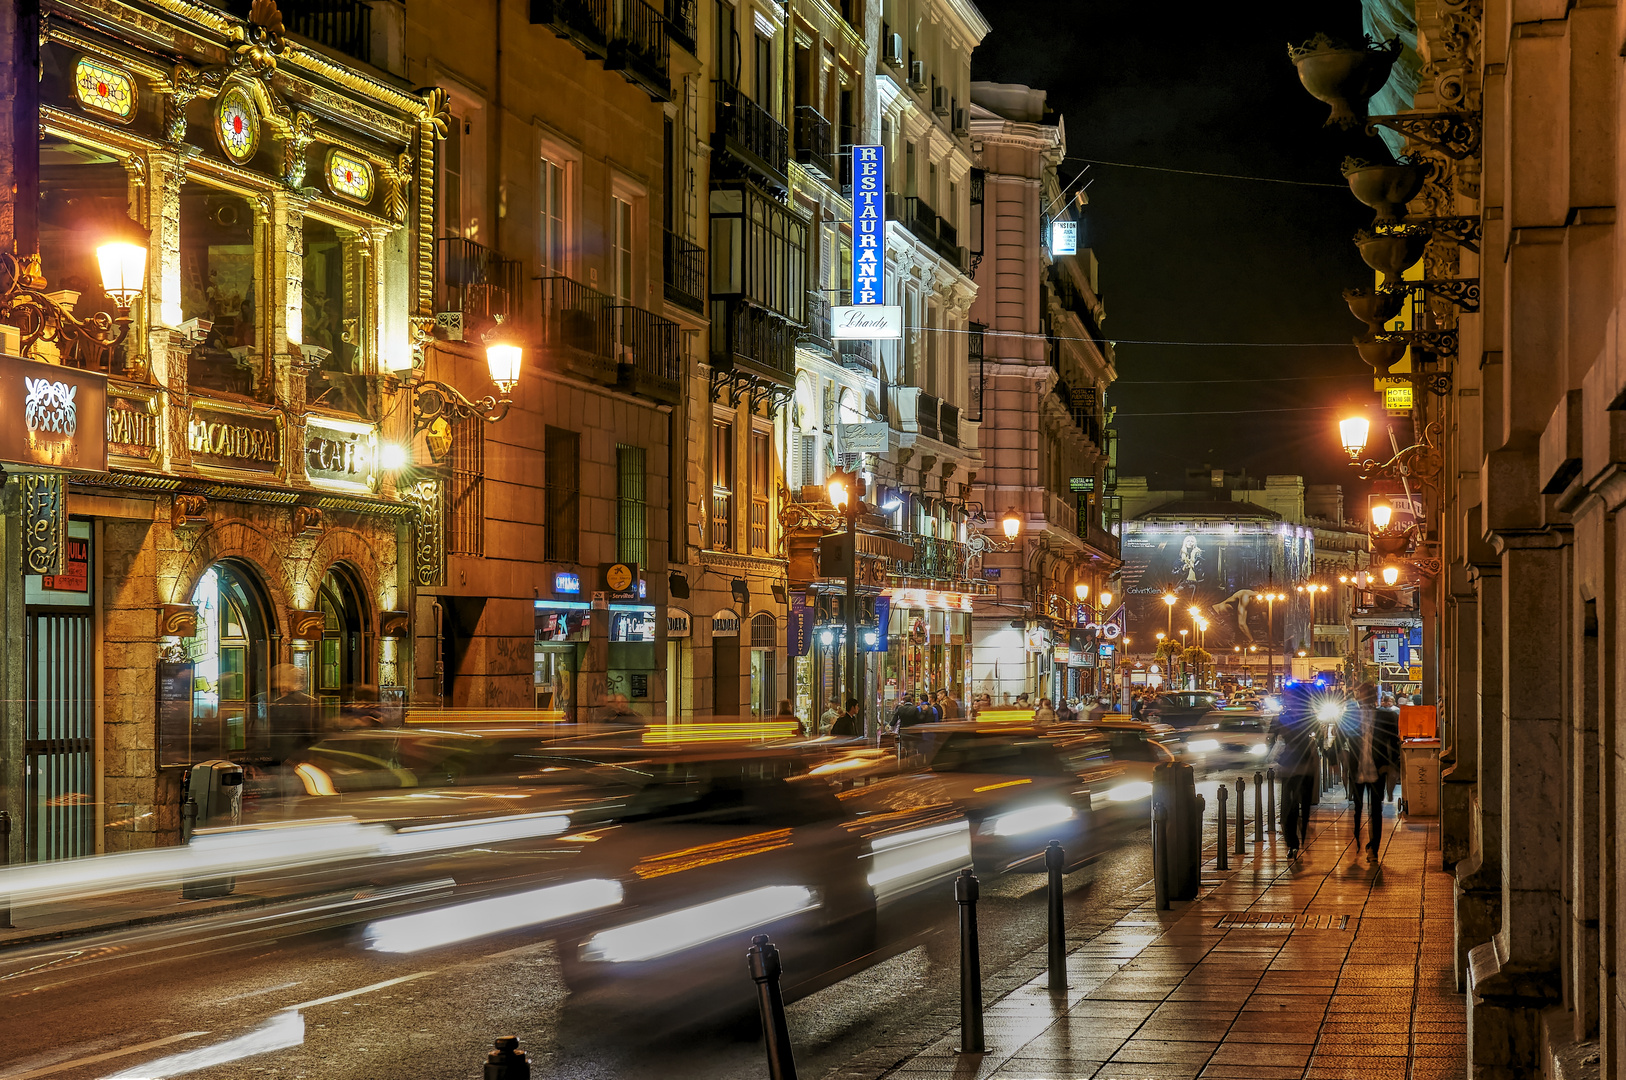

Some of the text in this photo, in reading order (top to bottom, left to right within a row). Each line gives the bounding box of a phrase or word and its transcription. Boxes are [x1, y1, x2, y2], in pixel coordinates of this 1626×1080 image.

[857, 148, 878, 304] RESTAURANTE
[839, 309, 888, 332] Lhardy
[556, 576, 580, 591] CHANGE
